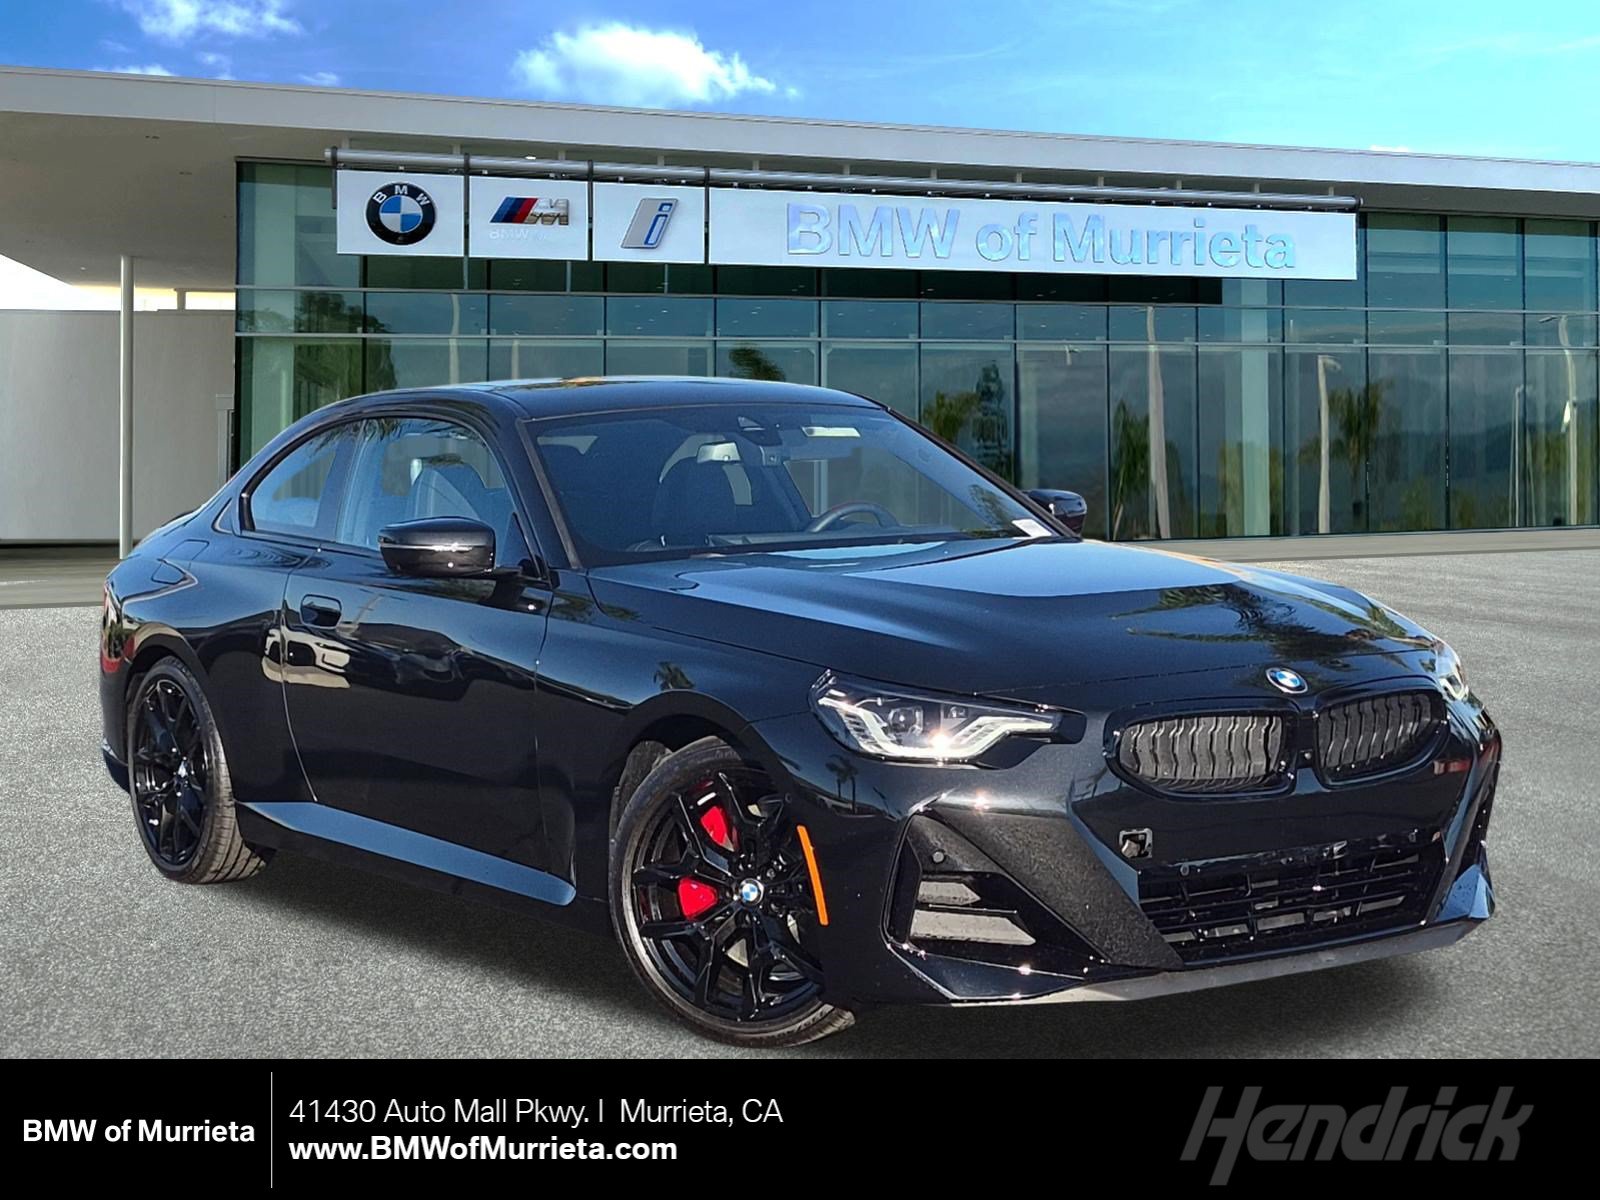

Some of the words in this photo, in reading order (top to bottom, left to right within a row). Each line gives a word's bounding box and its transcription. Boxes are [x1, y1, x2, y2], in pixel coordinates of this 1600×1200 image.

[372, 184, 431, 206] BMW
[787, 202, 961, 259] BMW
[975, 211, 1039, 263] of
[1052, 212, 1296, 270] Murrieta
